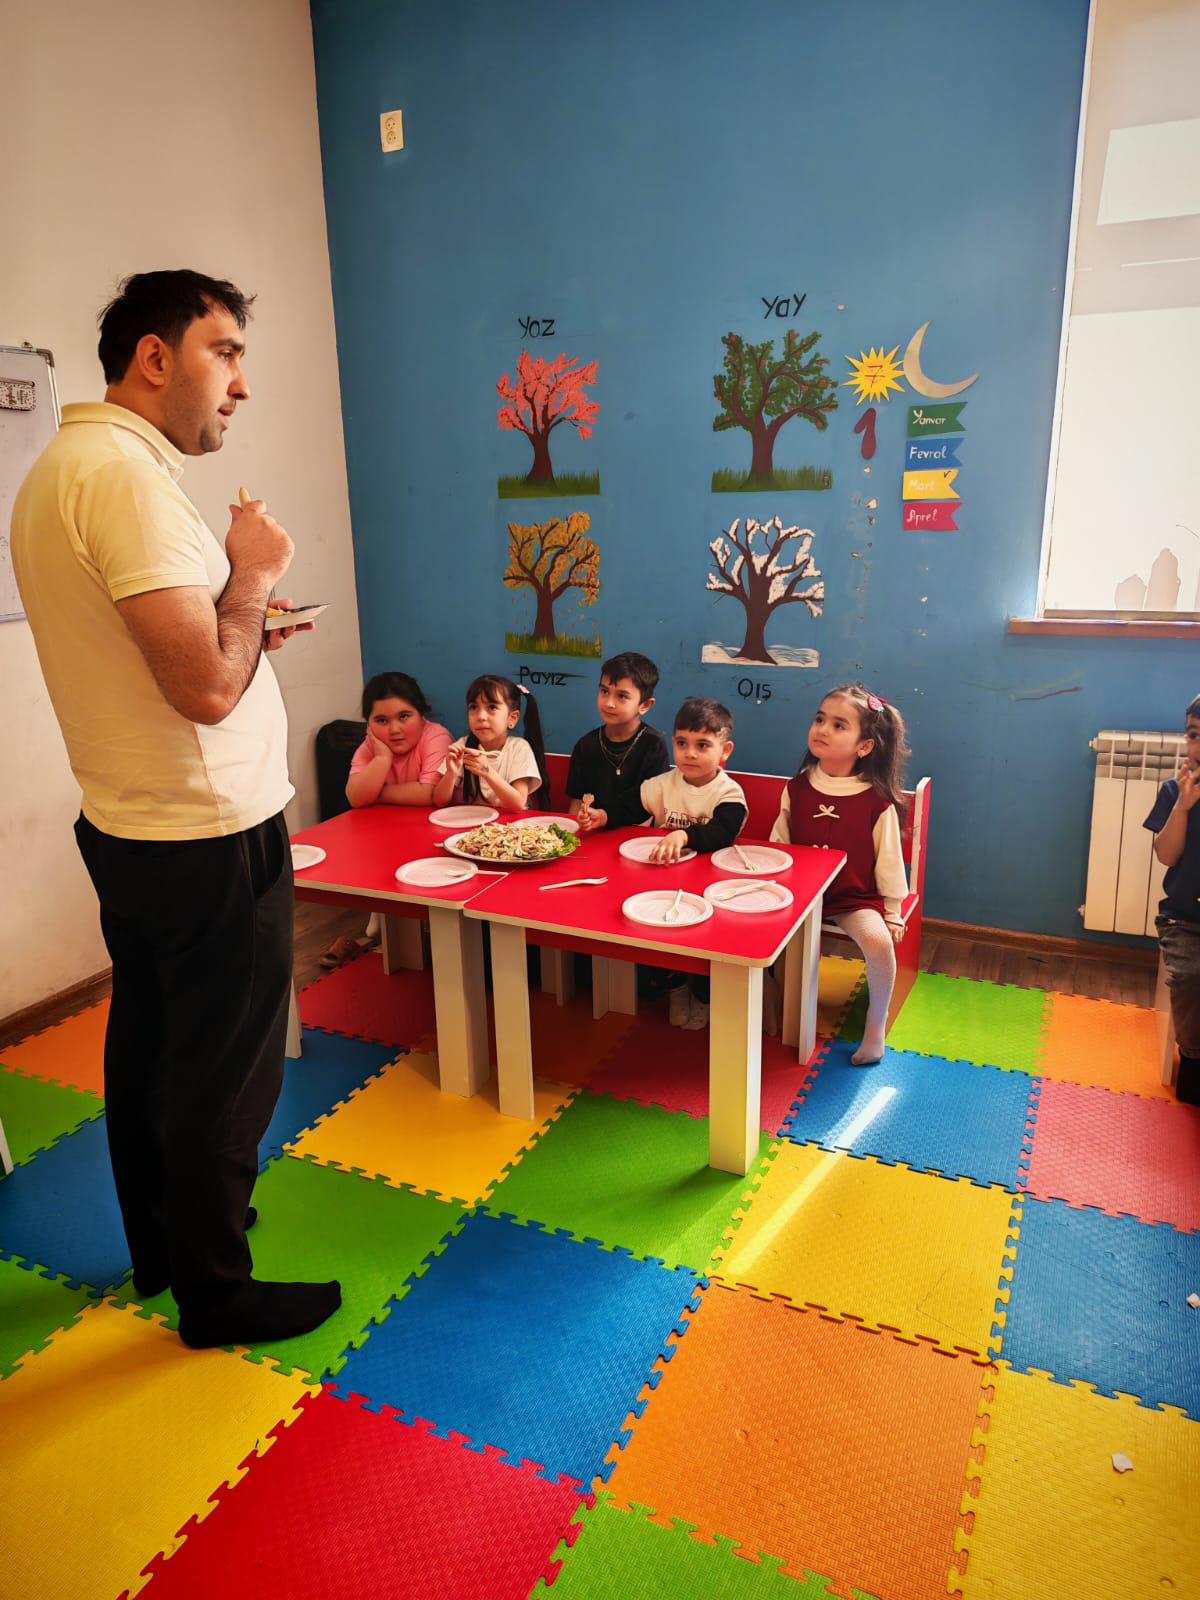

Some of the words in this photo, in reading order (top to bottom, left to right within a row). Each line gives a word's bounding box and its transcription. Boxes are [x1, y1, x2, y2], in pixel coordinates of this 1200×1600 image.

[518, 315, 555, 339] Yaz
[864, 364, 886, 388] 7
[913, 409, 947, 425] Yanvar
[909, 446, 948, 460] Fevral
[907, 479, 936, 492] Mart
[906, 508, 939, 528] Aprel
